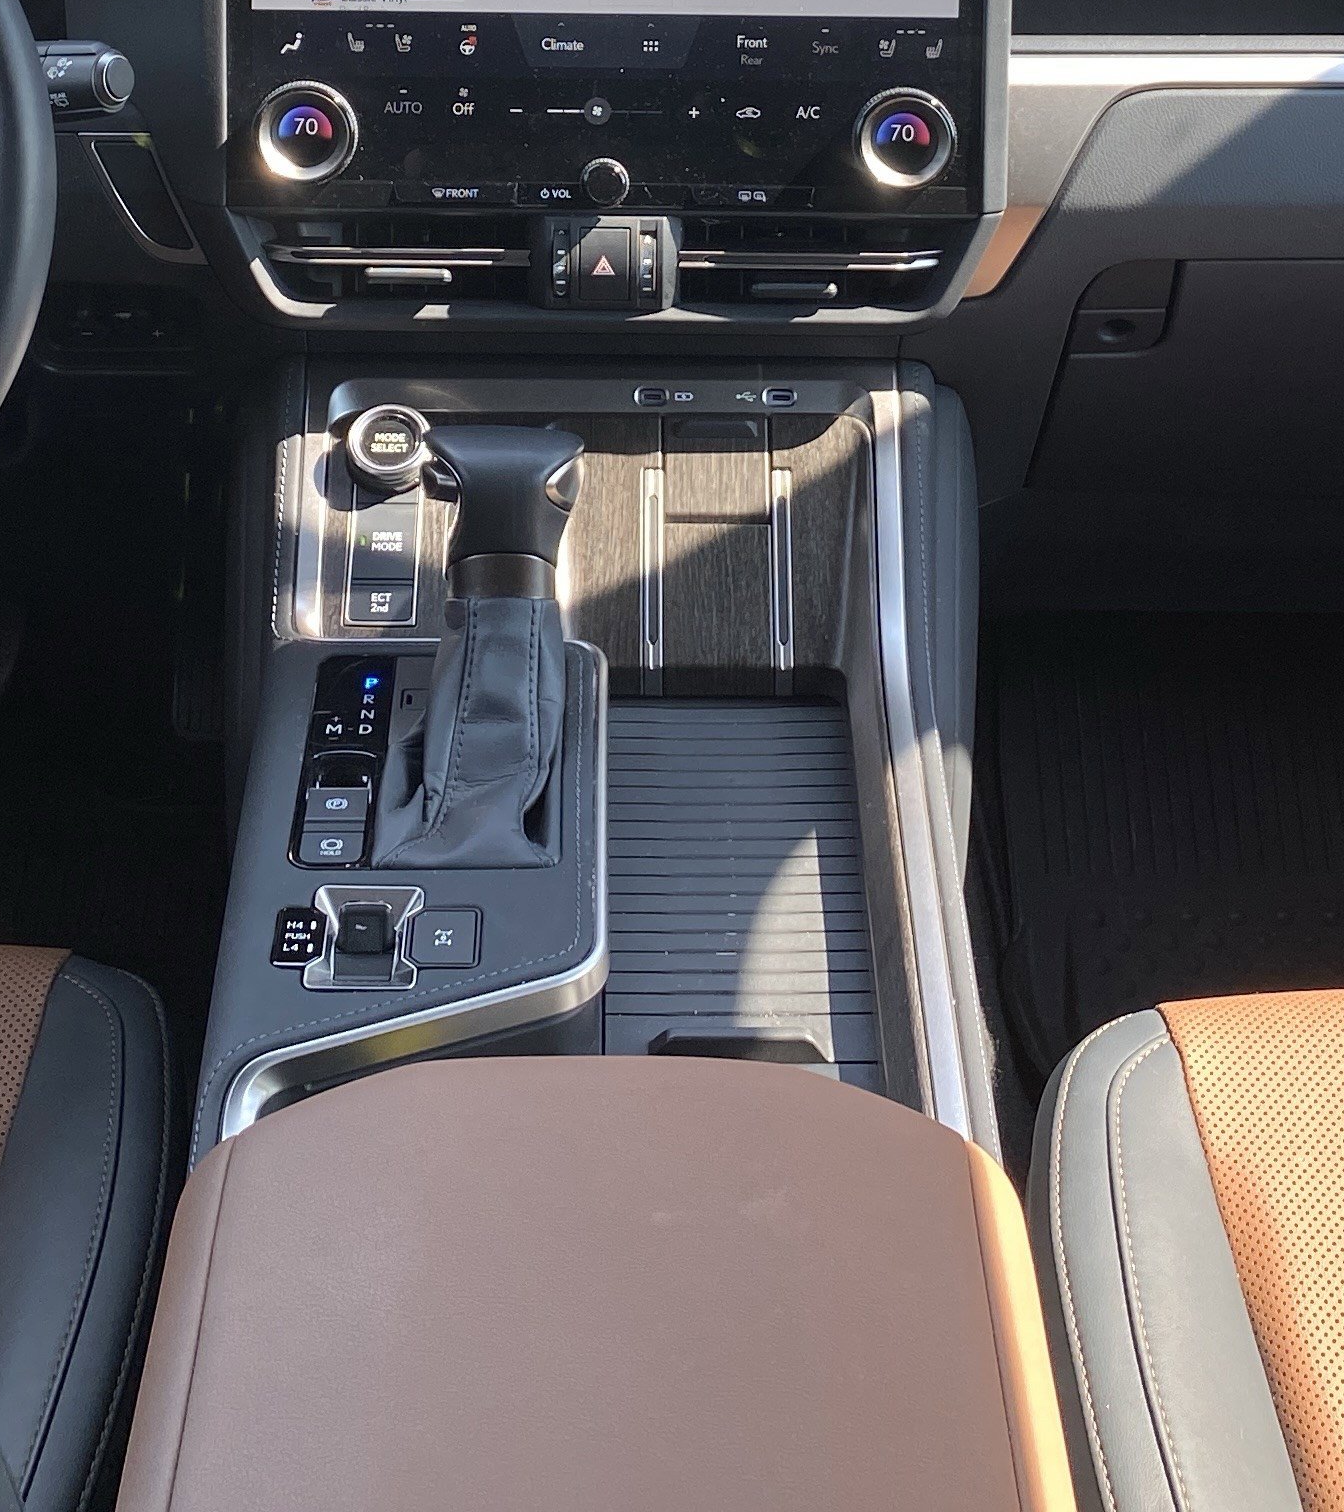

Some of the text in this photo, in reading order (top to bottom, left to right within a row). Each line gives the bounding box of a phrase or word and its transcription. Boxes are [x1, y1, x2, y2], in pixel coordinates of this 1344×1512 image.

[460, 24, 477, 32] AUTO
[542, 37, 584, 51] Climate
[737, 35, 768, 49] Front
[812, 41, 839, 56] Sync
[741, 54, 763, 66] Rear
[384, 101, 422, 115] AUTO
[453, 101, 475, 116] Off
[796, 105, 821, 120] A/C
[293, 117, 319, 135] 70
[890, 124, 915, 142] 70
[446, 188, 479, 199] FRONT
[552, 188, 572, 199] VOL
[374, 432, 406, 443] MODE
[370, 442, 409, 453] SELECT
[372, 532, 403, 541] DRIVE
[371, 542, 403, 551] MODE
[370, 593, 392, 602] ECT
[370, 603, 389, 612] 2nd
[365, 676, 379, 689] P
[363, 694, 374, 705] R
[361, 709, 375, 721] N
[325, 724, 373, 735] M D
[285, 932, 311, 940] PUSH
[283, 942, 299, 952] L4
